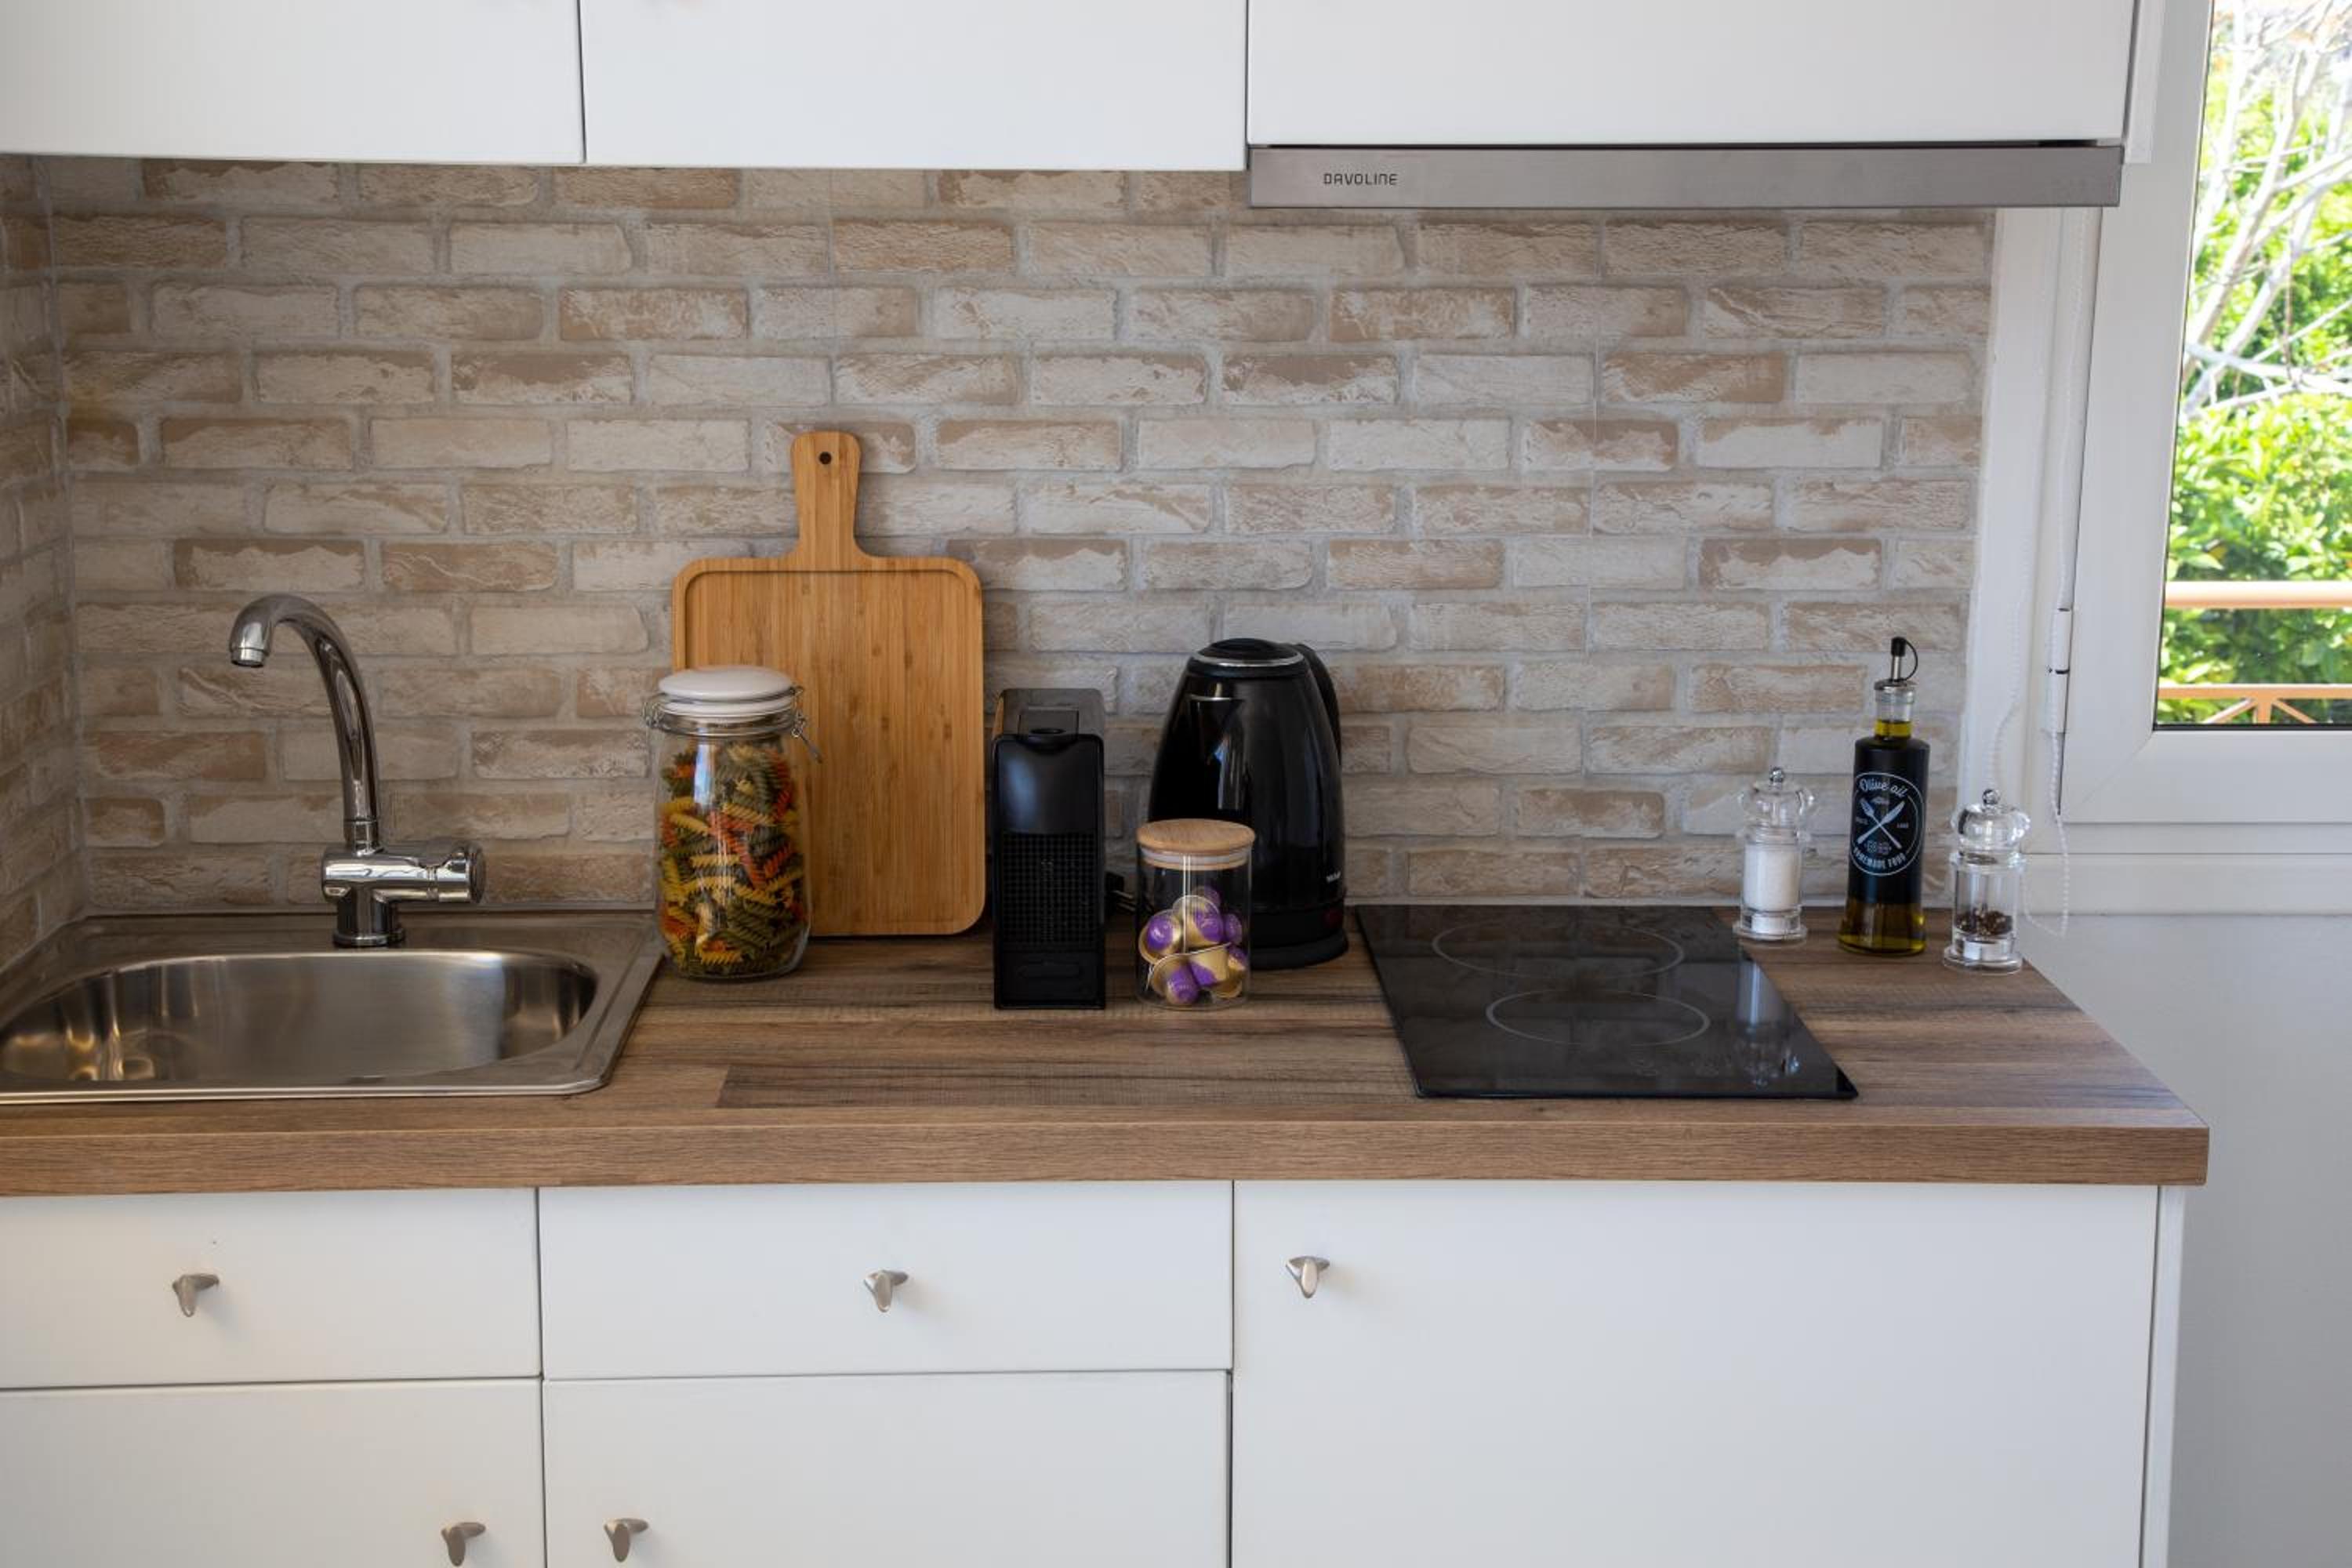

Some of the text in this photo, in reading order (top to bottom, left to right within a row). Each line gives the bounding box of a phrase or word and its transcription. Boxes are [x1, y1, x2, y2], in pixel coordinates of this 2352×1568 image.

[1323, 173, 1399, 185] DAVOLINE
[1860, 779, 1907, 798] Olive oil
